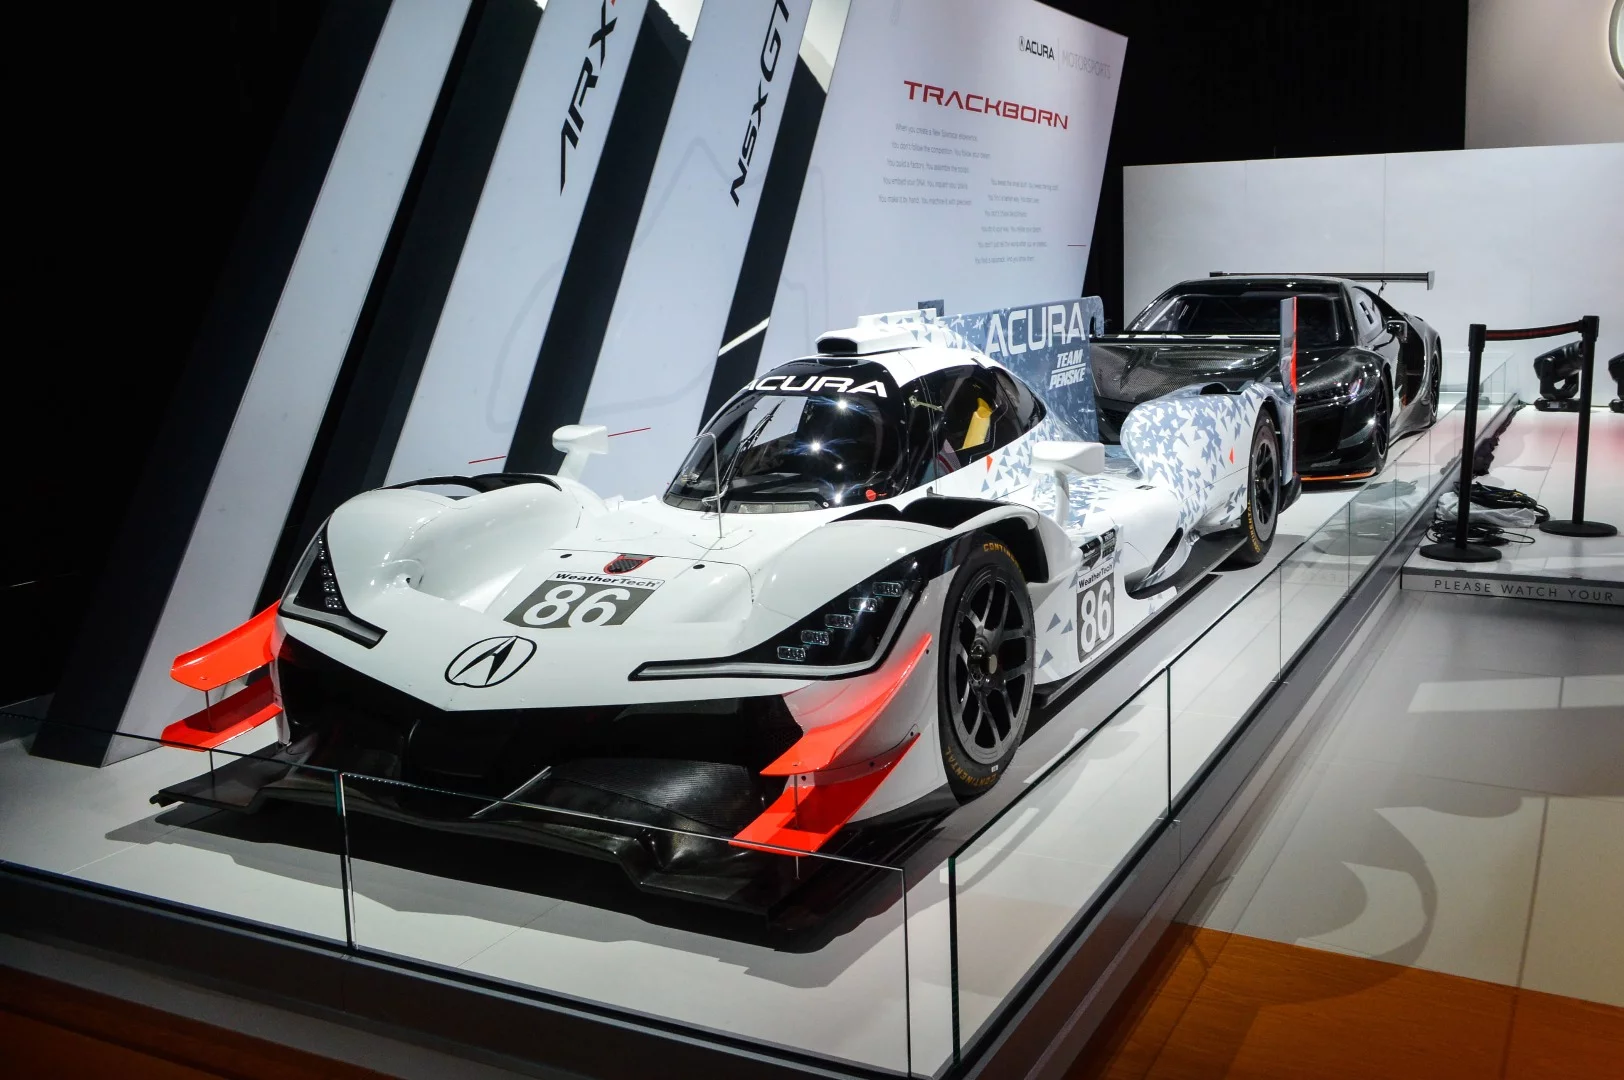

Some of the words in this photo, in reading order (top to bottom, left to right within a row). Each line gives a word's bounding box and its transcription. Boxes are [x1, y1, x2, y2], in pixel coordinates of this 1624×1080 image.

[1025, 39, 1055, 60] ACURA
[1061, 50, 1111, 79] MOTORSPORTS
[903, 80, 1068, 129] TRACKBORN
[730, 79, 768, 207] NSX
[984, 302, 1086, 357] ACURA
[1049, 367, 1086, 390] PENSKE
[1057, 349, 1083, 368] TEAM
[744, 375, 888, 398] ACURA
[556, 573, 658, 588] WeatherTech
[1079, 564, 1113, 588] WeatherTech
[1434, 579, 1491, 593] PLEASE
[1501, 584, 1557, 597] WATCH
[1568, 589, 1613, 601] YOUR
[523, 583, 630, 628] 86
[1081, 580, 1112, 653] 86
[945, 744, 998, 786] CONTINENTAL
